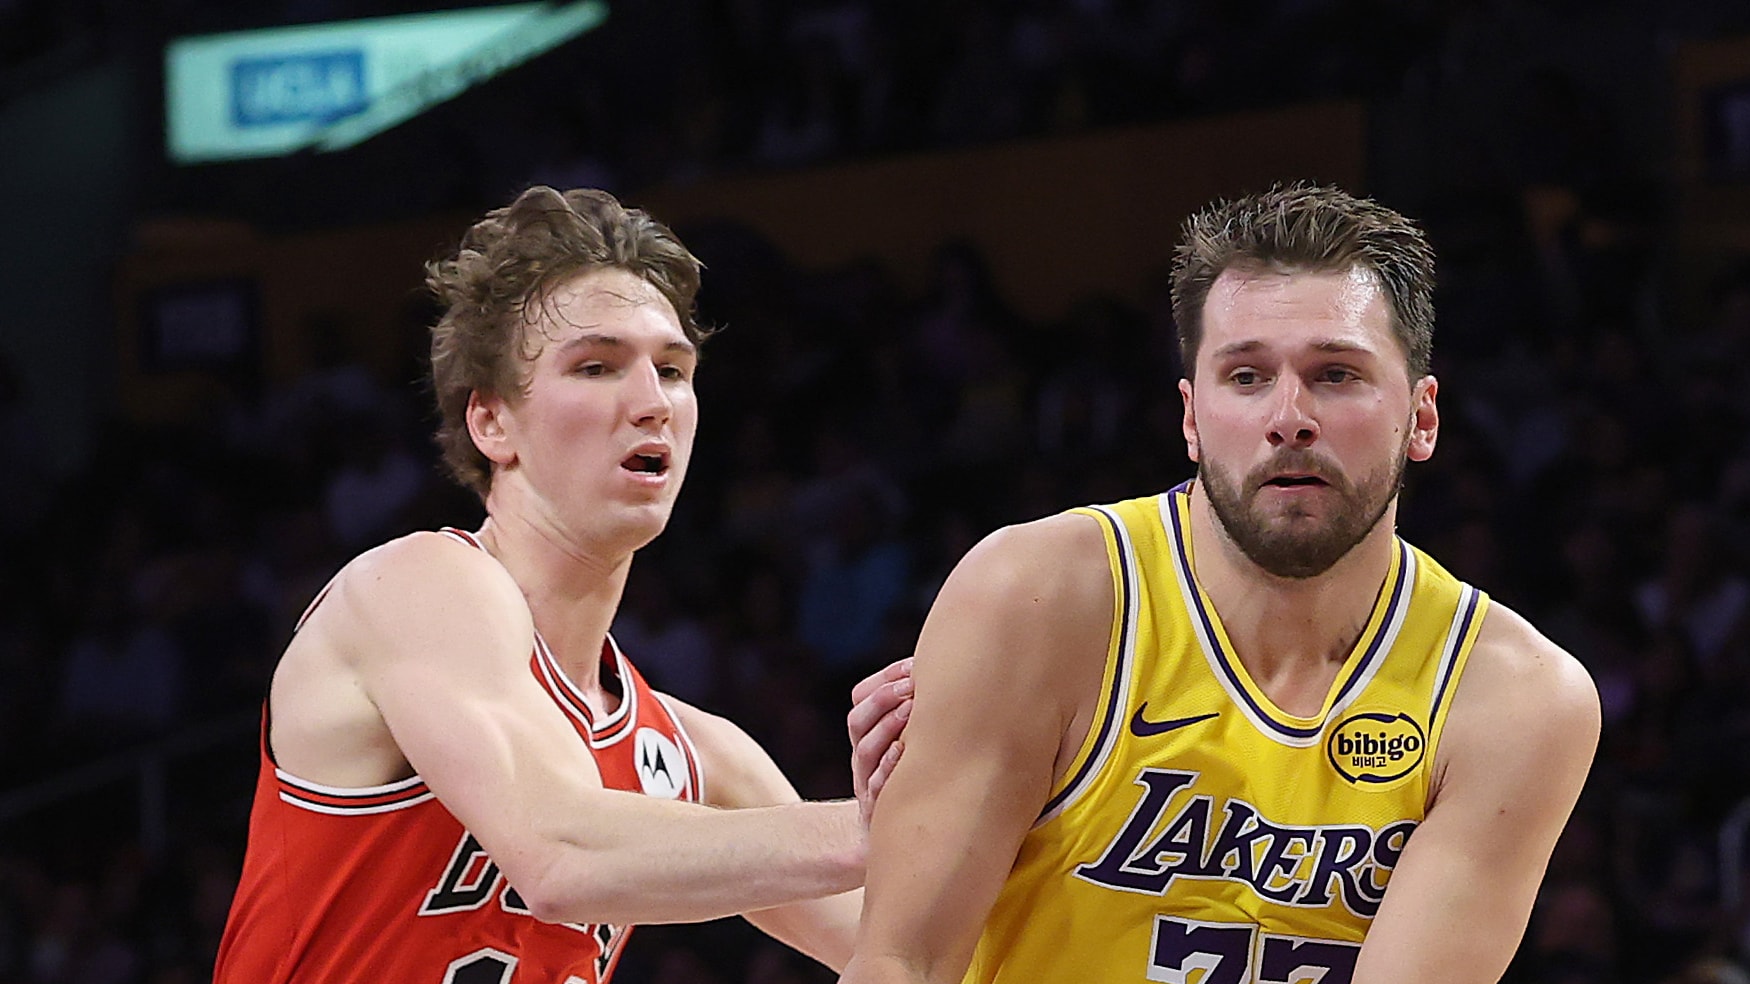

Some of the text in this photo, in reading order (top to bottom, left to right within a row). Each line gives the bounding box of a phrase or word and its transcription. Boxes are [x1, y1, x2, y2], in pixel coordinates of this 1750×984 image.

[1337, 731, 1420, 761] bibigo
[1351, 756, 1387, 769] 비비고
[1072, 766, 1424, 920] LAKERS
